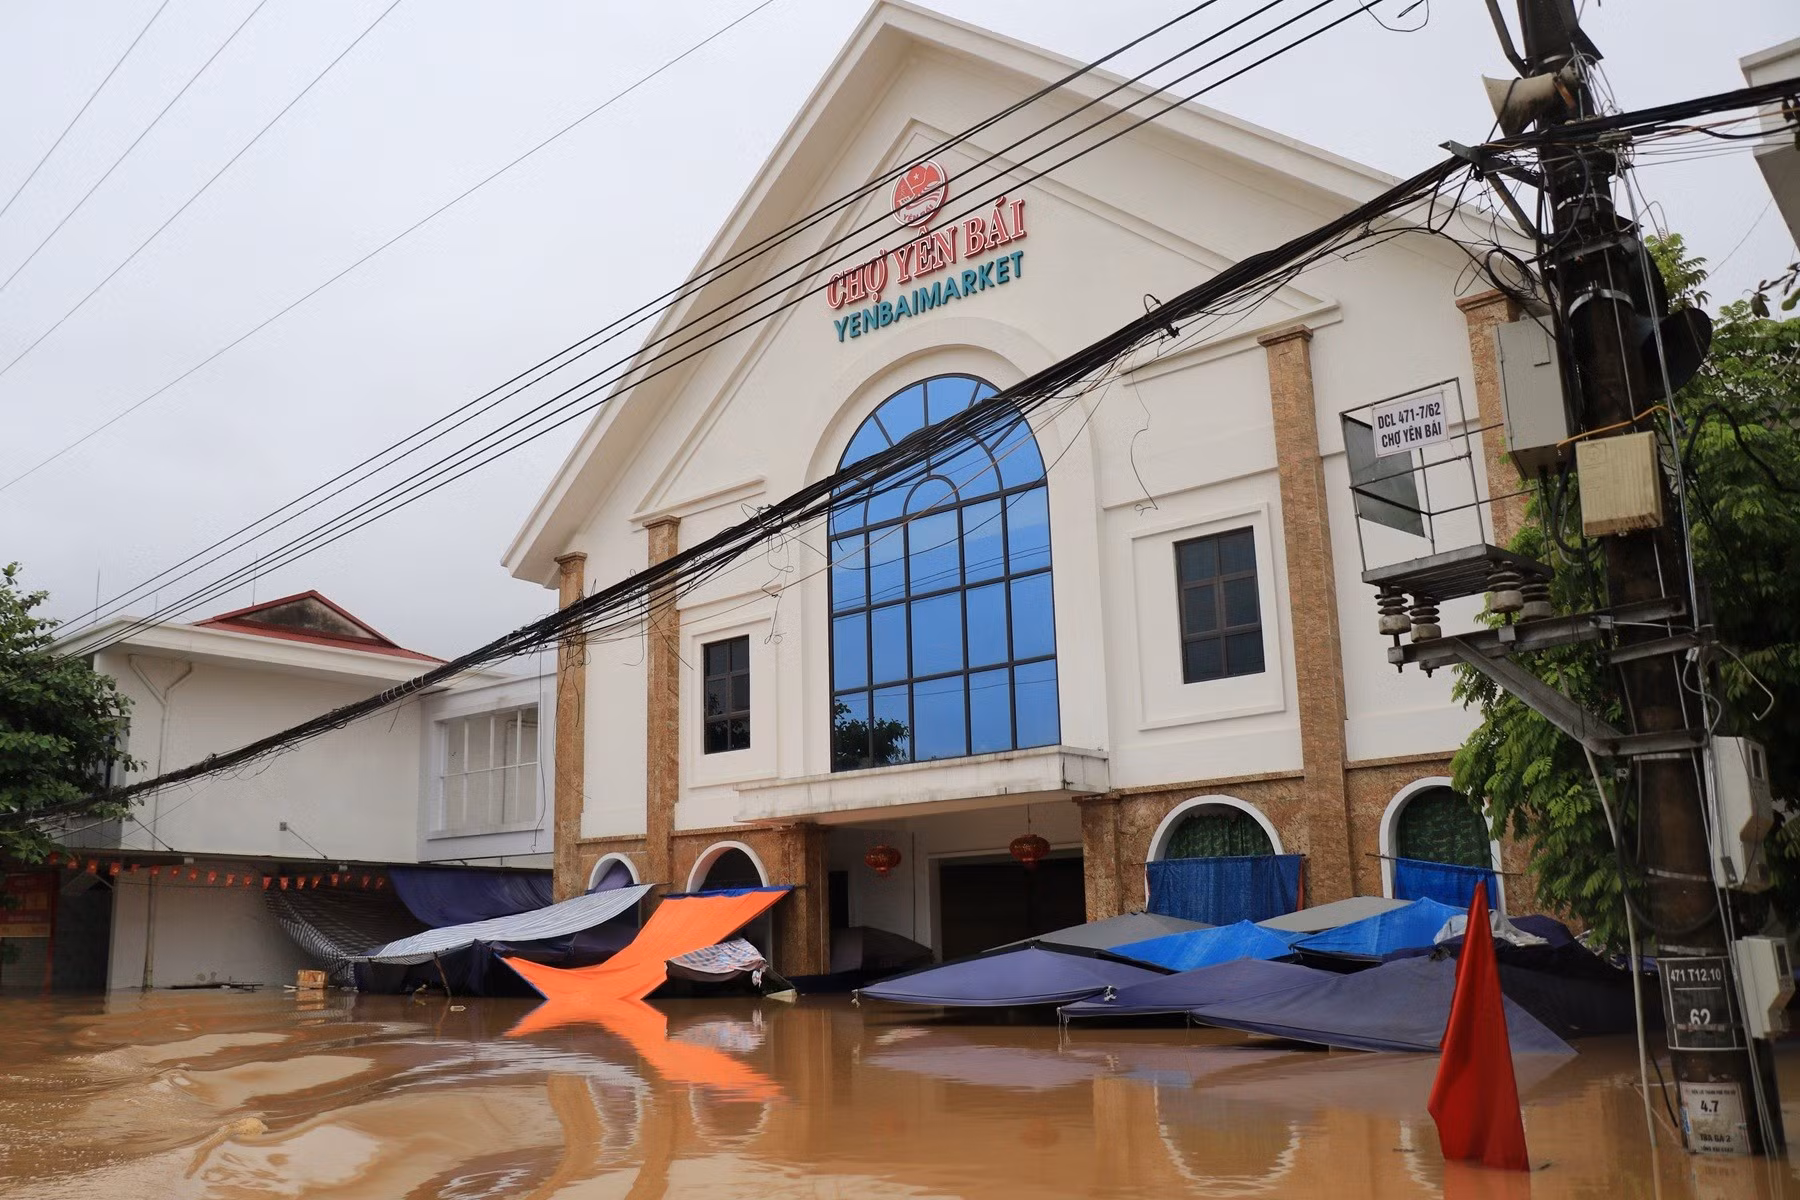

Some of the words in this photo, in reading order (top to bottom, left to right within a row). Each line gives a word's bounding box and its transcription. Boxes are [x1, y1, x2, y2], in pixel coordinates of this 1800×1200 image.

[825, 248, 889, 310] CHỢ
[891, 225, 957, 285] YÊN
[961, 196, 1028, 259] BÁI
[833, 250, 1024, 343] YENBAIMARKET
[1378, 414, 1396, 430] DCL
[1398, 402, 1441, 424] 471-7/62
[1381, 430, 1401, 448] CHỢ
[1402, 425, 1423, 443] YÊN
[1425, 420, 1442, 438] BÁI
[1670, 969, 1686, 983] 471
[1687, 968, 1721, 982] T12.10
[1690, 1008, 1711, 1027] 62
[1700, 1100, 1719, 1113] 4.7
